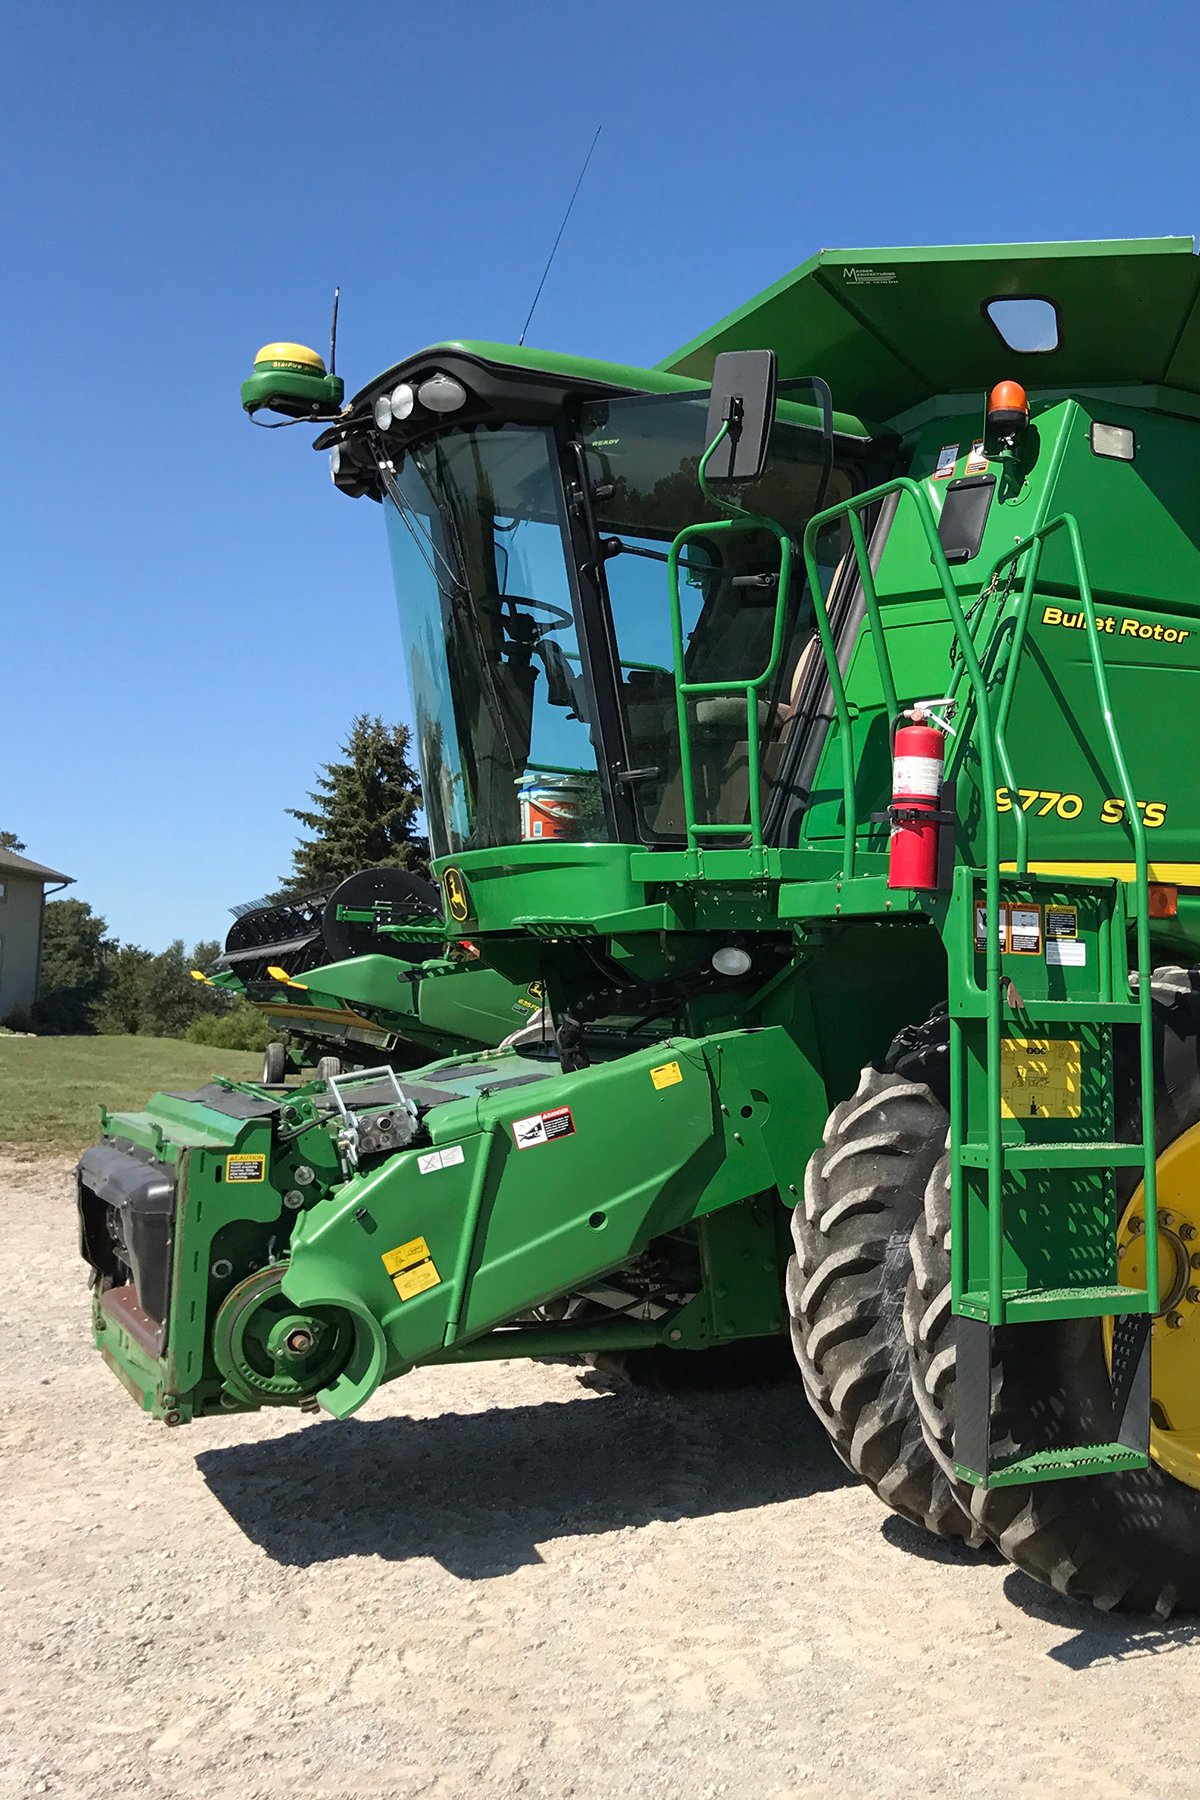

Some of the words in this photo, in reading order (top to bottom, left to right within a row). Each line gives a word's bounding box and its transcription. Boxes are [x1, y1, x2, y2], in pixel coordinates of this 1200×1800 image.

[272, 361, 302, 369] StarFire
[591, 439, 620, 447] READY
[1042, 606, 1116, 633] Bulet
[1119, 618, 1189, 644] Rotor
[995, 787, 1083, 819] 9770
[547, 1107, 569, 1117] DANGER
